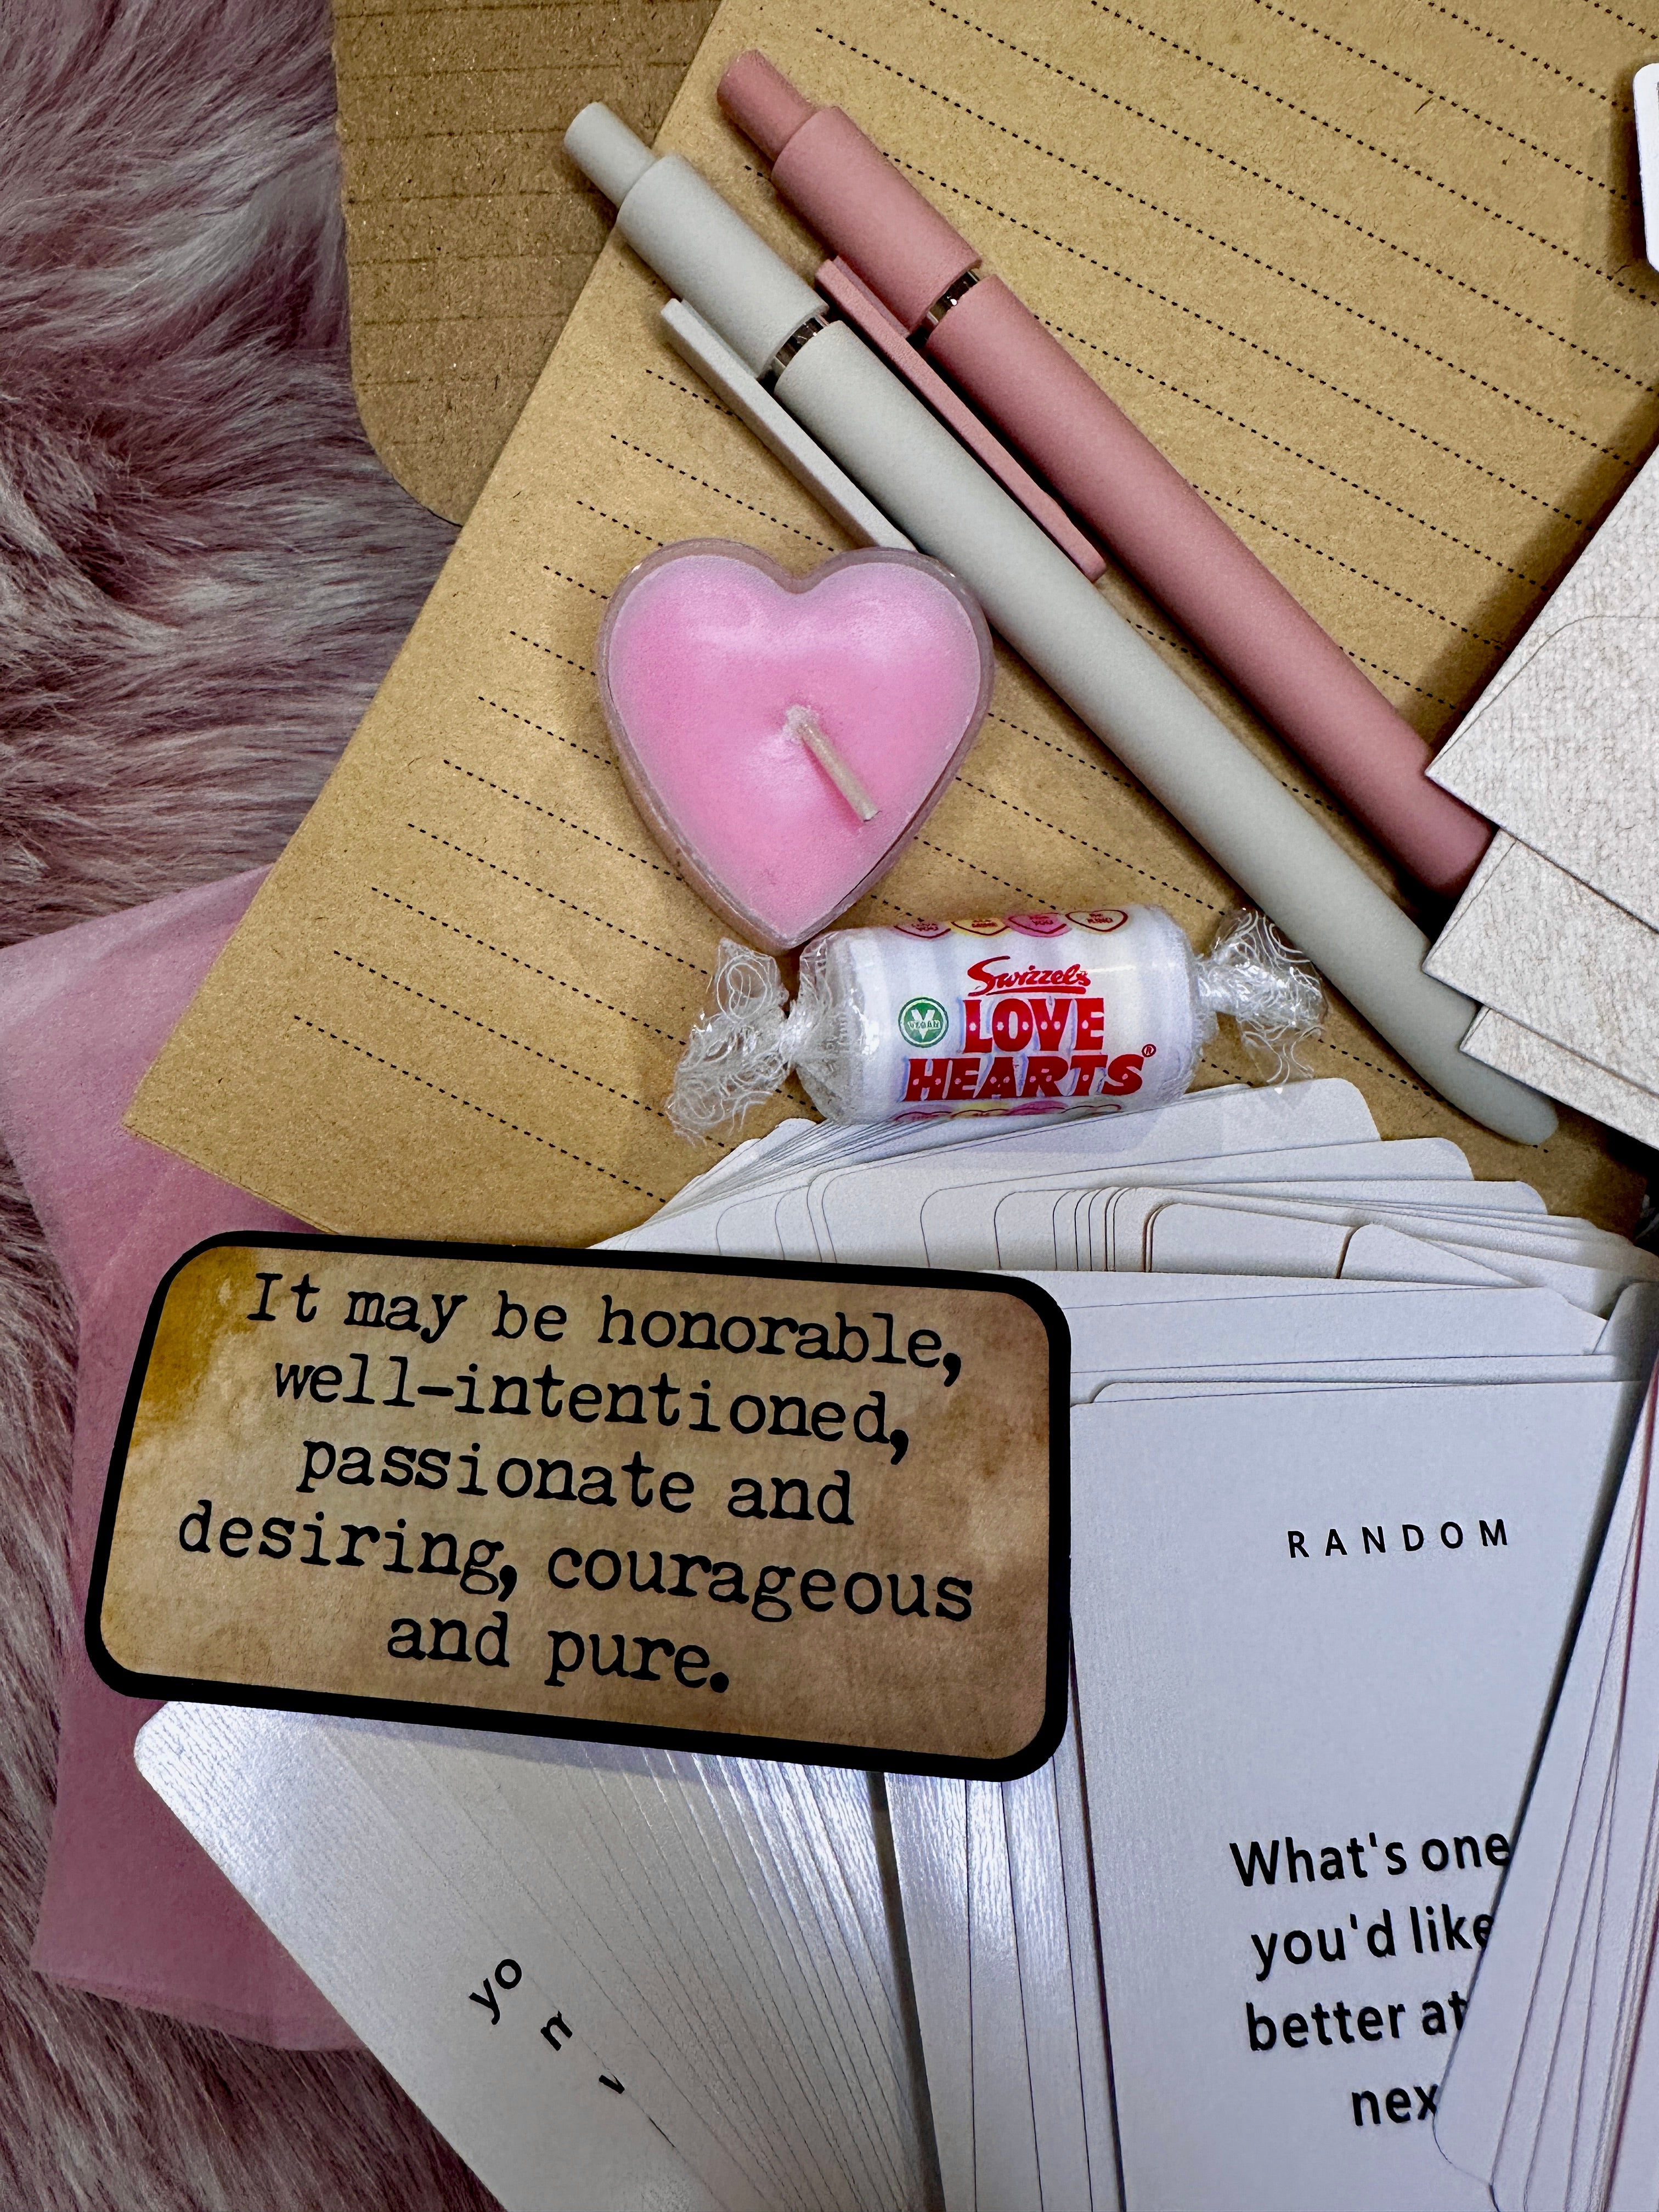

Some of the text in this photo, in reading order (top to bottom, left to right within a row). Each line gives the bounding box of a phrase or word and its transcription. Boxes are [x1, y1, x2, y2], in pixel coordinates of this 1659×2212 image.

[967, 955, 1091, 996] Swizzels
[963, 997, 1104, 1053] LOVE
[247, 1272, 962, 1388] It may be honorable,
[274, 1355, 910, 1466] well-intentioned,
[295, 1440, 854, 1526] passionate and
[178, 1499, 973, 1623] desiring, courageous
[1288, 1519, 1508, 1558] RANDOM
[387, 1610, 730, 1694] and pure.
[1229, 1832, 1511, 1887] What's one
[1251, 1903, 1494, 1982] you'd like
[1245, 1990, 1468, 2052] better at
